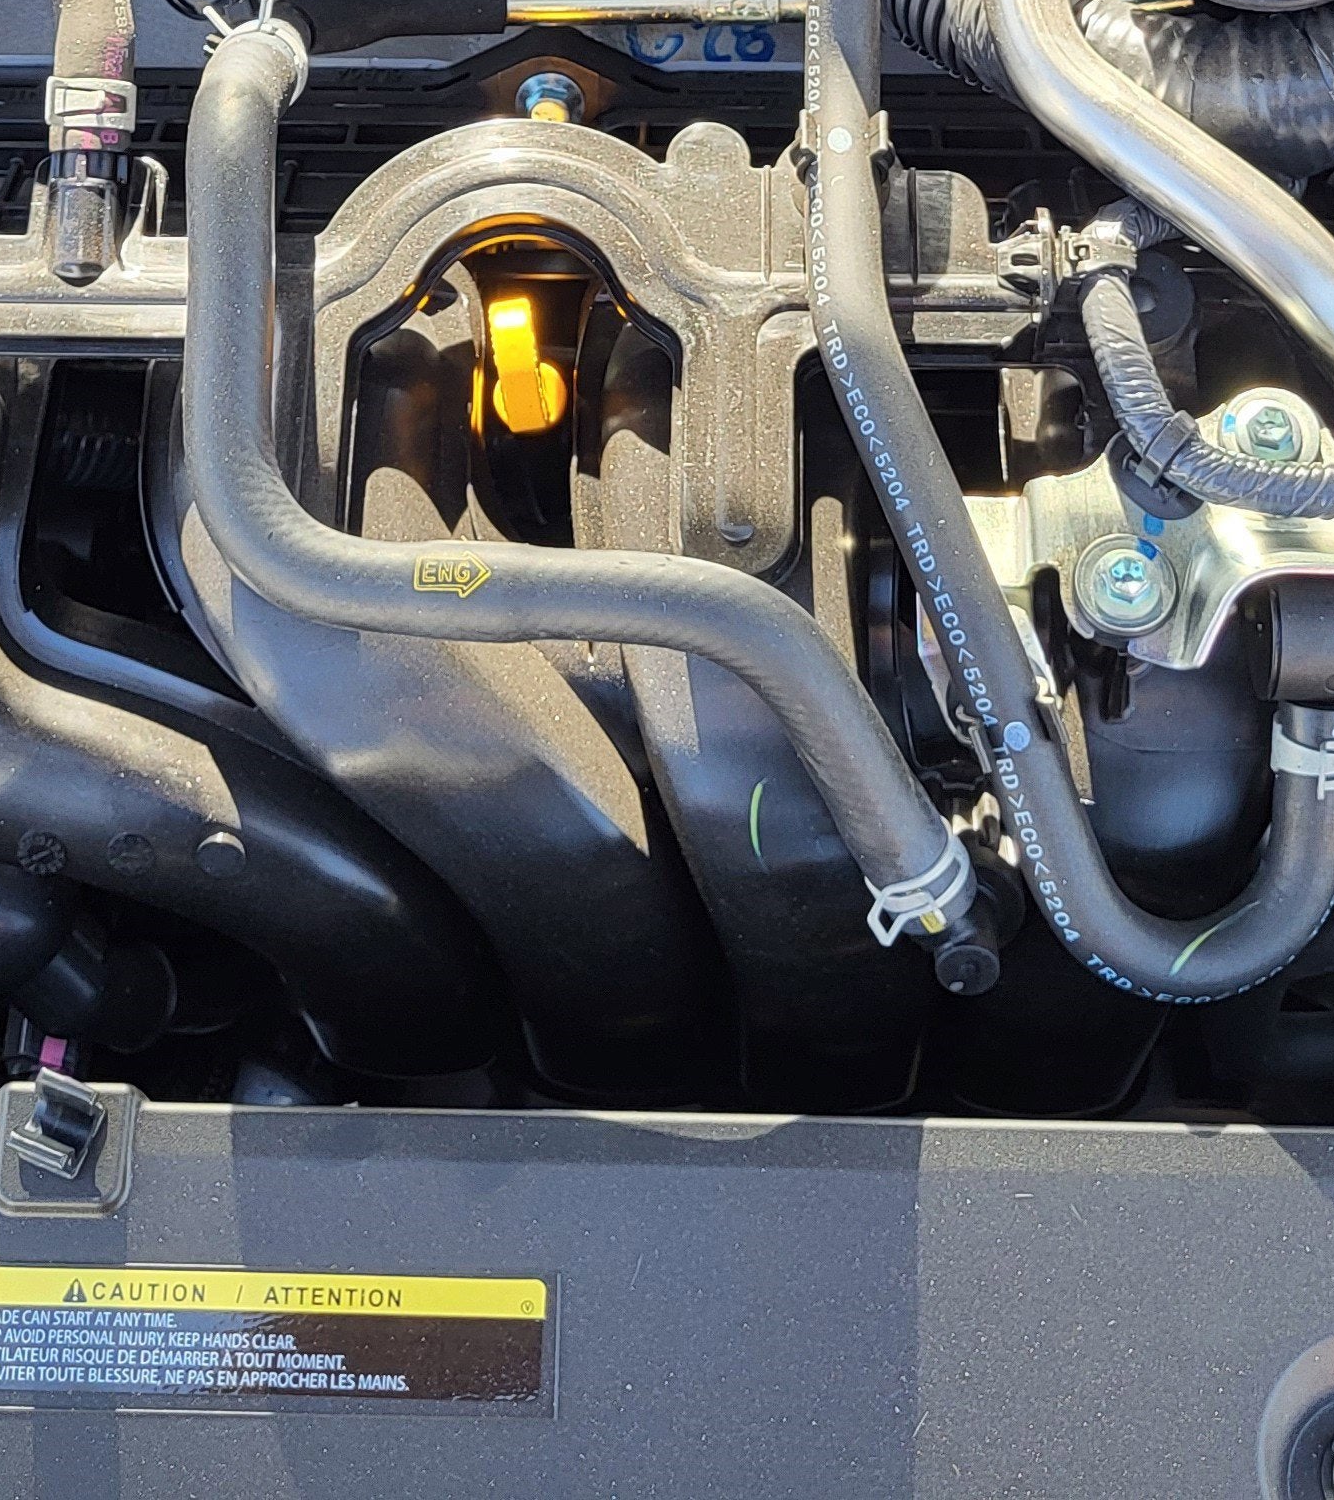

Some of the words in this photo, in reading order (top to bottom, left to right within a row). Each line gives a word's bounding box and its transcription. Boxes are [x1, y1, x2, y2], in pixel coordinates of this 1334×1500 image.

[422, 561, 471, 584] ENG
[92, 1281, 206, 1303] CAUTION
[263, 1285, 403, 1308] ATTENTION
[22, 1310, 51, 1326] CAN
[52, 1310, 92, 1327] START
[94, 1311, 111, 1327] AT
[113, 1311, 143, 1328] ANY
[143, 1312, 178, 1329] TIME.
[4, 1328, 46, 1344] AVOID
[48, 1329, 116, 1346] PERSONAL
[119, 1331, 166, 1349] INJURY,
[168, 1331, 200, 1348] KEEP
[202, 1332, 250, 1350] HANDS
[252, 1333, 297, 1351] CLEAR.
[62, 1348, 116, 1367] RISQUE
[118, 1349, 135, 1365] DE
[138, 1346, 219, 1367] DÉMARRER
[222, 1348, 235, 1368] À
[236, 1352, 276, 1369] TOUT
[277, 1353, 347, 1370] MOMENT.
[37, 1366, 85, 1382] TOUTE
[89, 1367, 162, 1386] BLESSURE,
[164, 1368, 185, 1385] NE
[187, 1369, 215, 1386] PAS
[219, 1370, 238, 1387] EN
[239, 1371, 328, 1389] APPROCHER
[330, 1374, 356, 1390] LES
[358, 1374, 410, 1392] MAINS.
